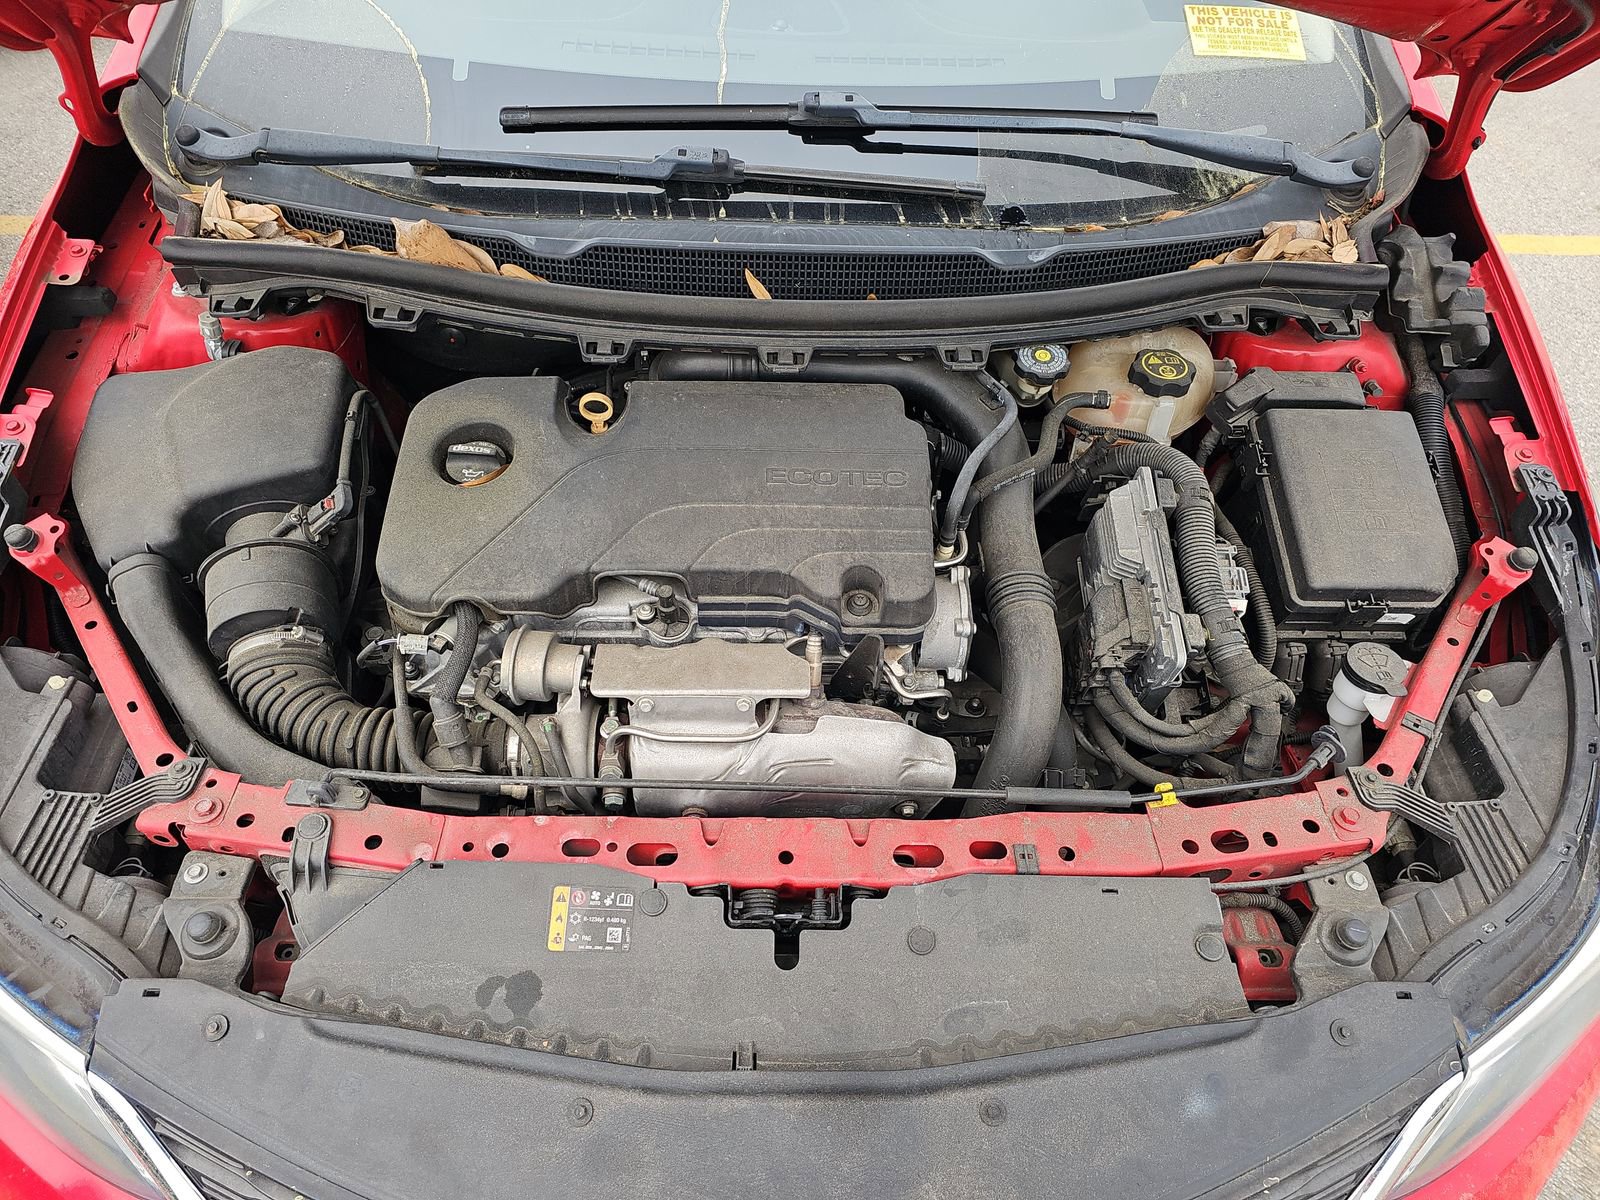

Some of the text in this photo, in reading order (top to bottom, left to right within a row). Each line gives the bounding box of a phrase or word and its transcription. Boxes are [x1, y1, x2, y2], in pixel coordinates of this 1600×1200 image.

[1188, 6, 1292, 19] THIS VEHICLE IS
[1196, 16, 1289, 28] NOT FOR SALE
[452, 444, 492, 454] dexos
[765, 466, 908, 487] ECOTEC
